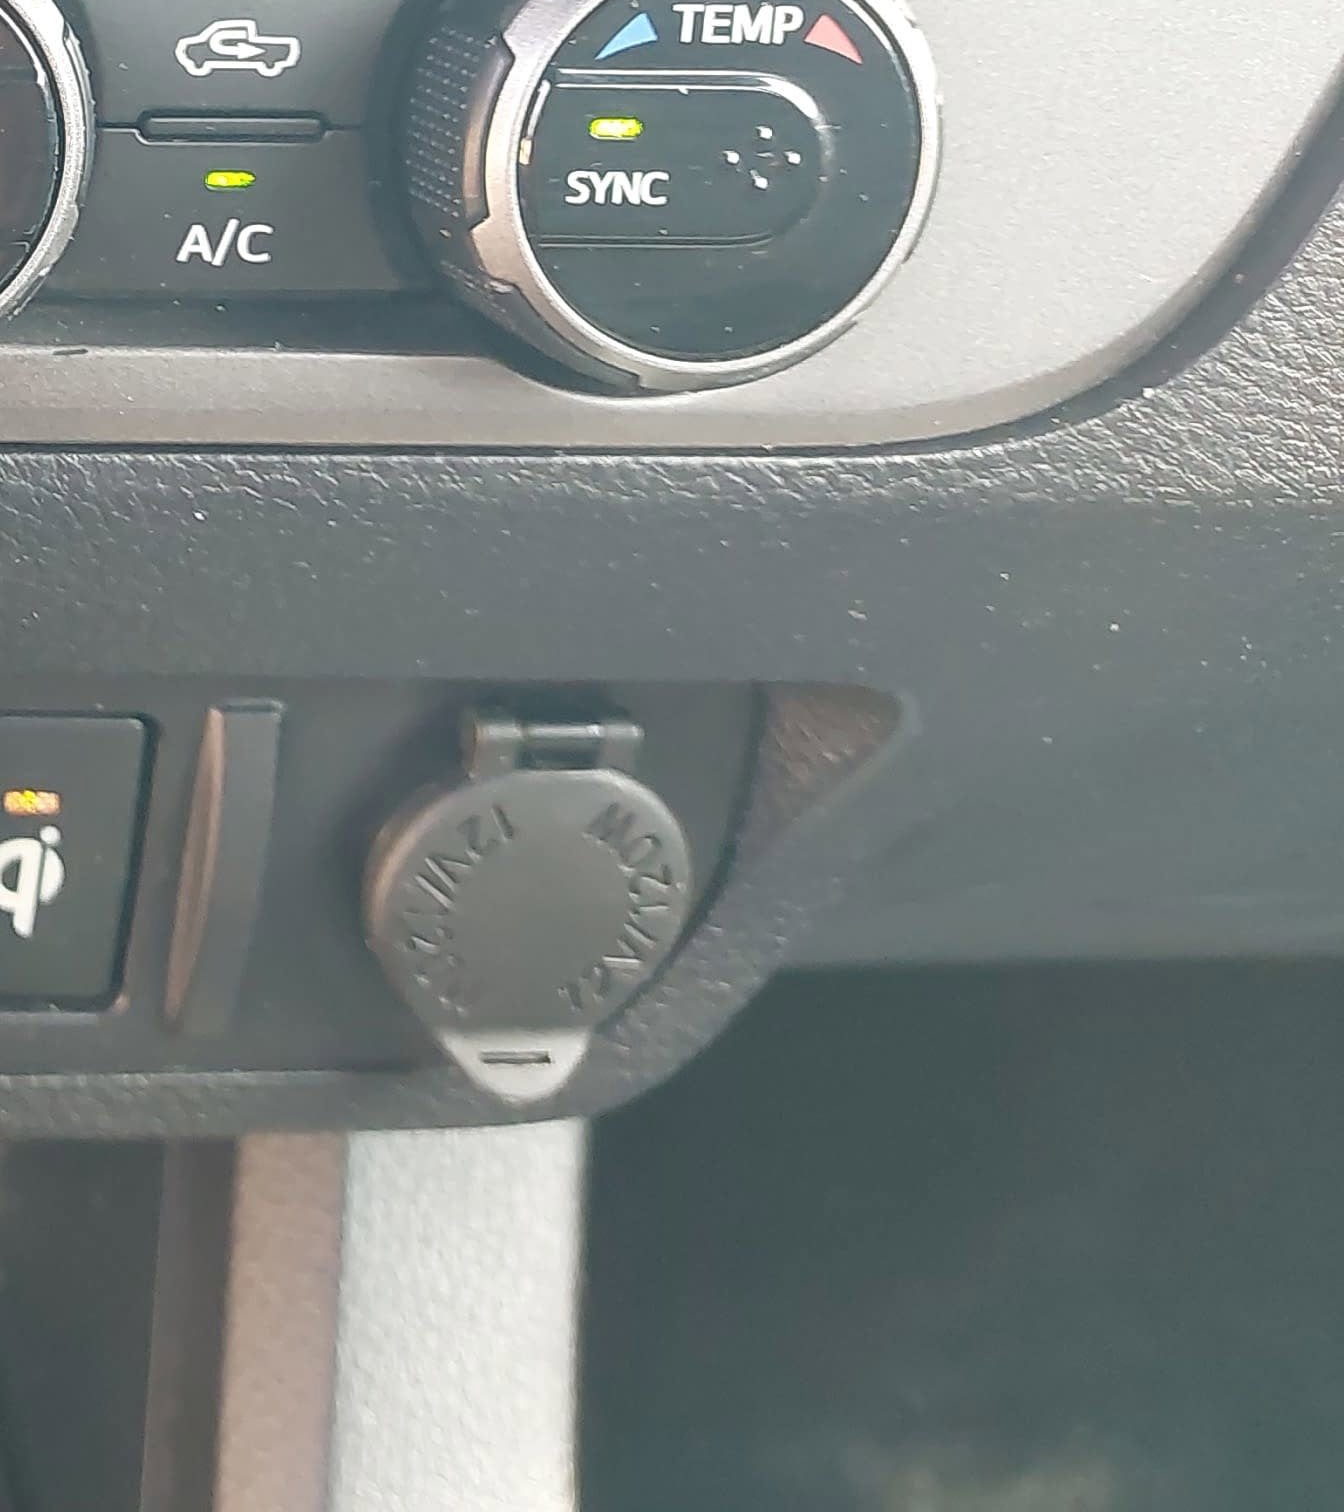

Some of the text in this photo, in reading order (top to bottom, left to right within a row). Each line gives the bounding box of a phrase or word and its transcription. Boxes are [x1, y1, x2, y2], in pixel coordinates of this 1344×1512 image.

[672, 2, 805, 46] TEMP
[564, 169, 669, 208] SYNC
[175, 218, 273, 265] A/C
